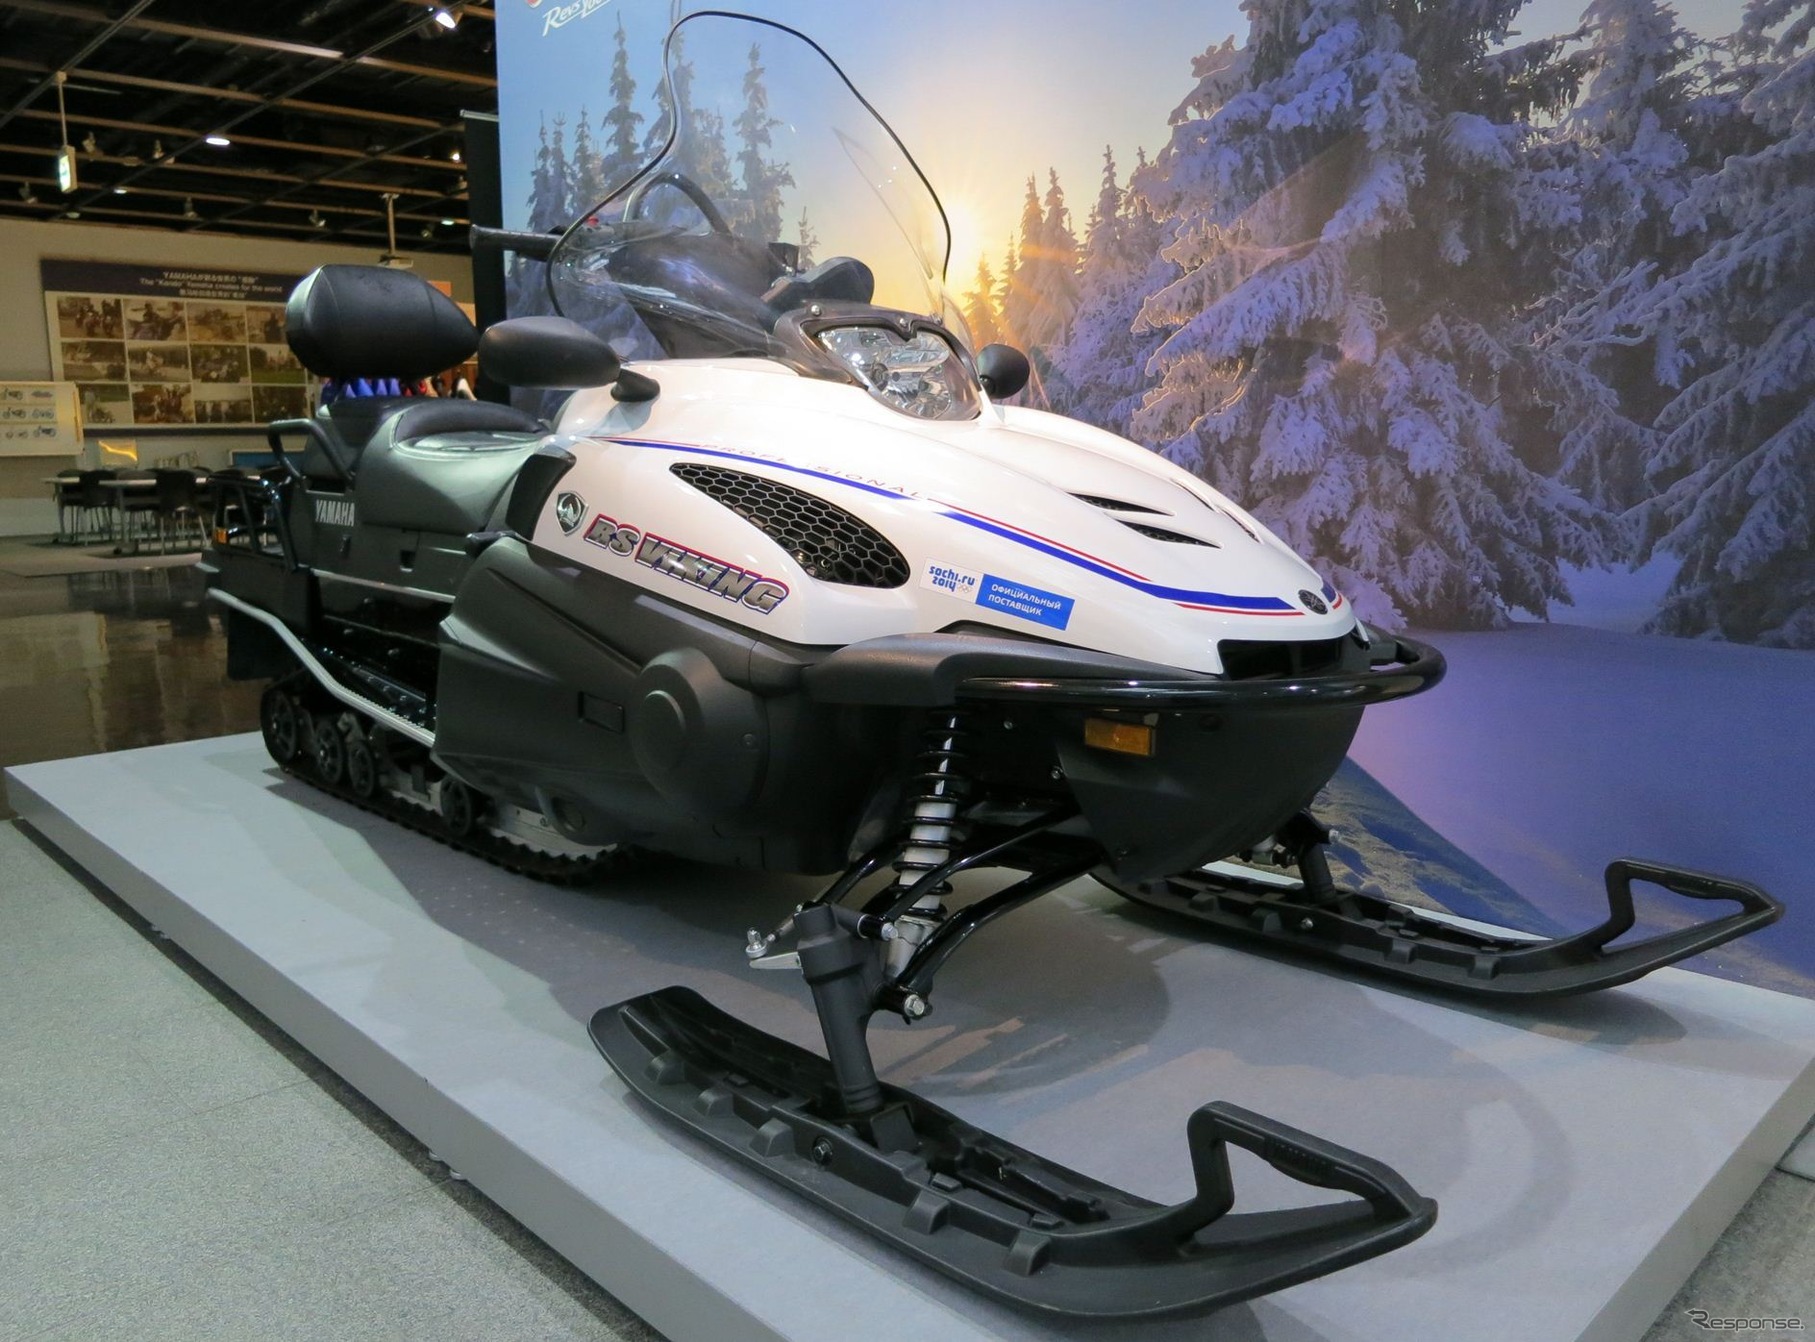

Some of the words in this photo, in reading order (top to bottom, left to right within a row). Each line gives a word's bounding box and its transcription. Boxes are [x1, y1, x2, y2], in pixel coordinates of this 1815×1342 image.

[542, 1, 582, 37] Revs
[315, 499, 355, 527] YAMAHA
[583, 513, 641, 557] RS
[635, 532, 790, 615] VIKING
[929, 566, 975, 586] sochi.ru
[988, 594, 1043, 616] ПОСТАВЩИК
[991, 583, 1062, 610] ОФИЦИАЛЬНЫЙ
